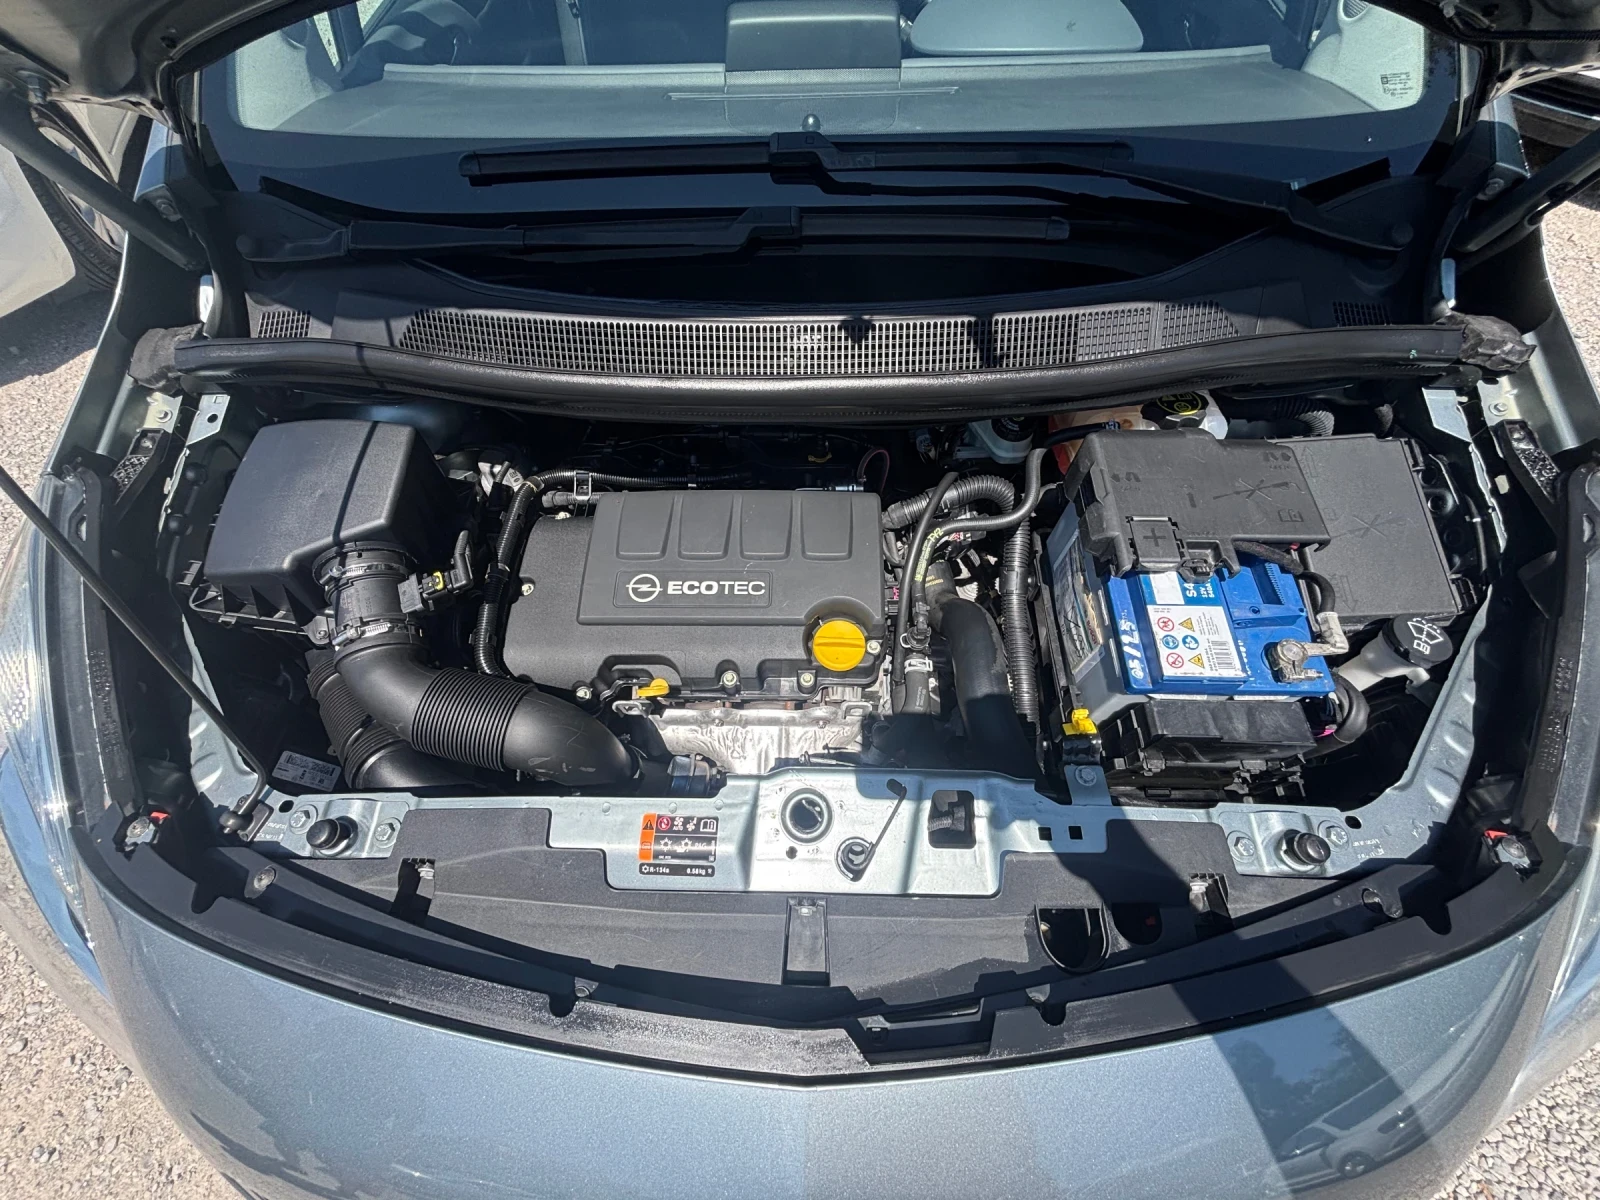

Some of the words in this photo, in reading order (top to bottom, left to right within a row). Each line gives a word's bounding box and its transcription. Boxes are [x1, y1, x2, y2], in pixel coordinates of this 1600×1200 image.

[667, 580, 766, 596] ECOTEC
[1183, 583, 1198, 598] S4
[1199, 586, 1208, 598] 12V
[649, 865, 670, 874] R-134a
